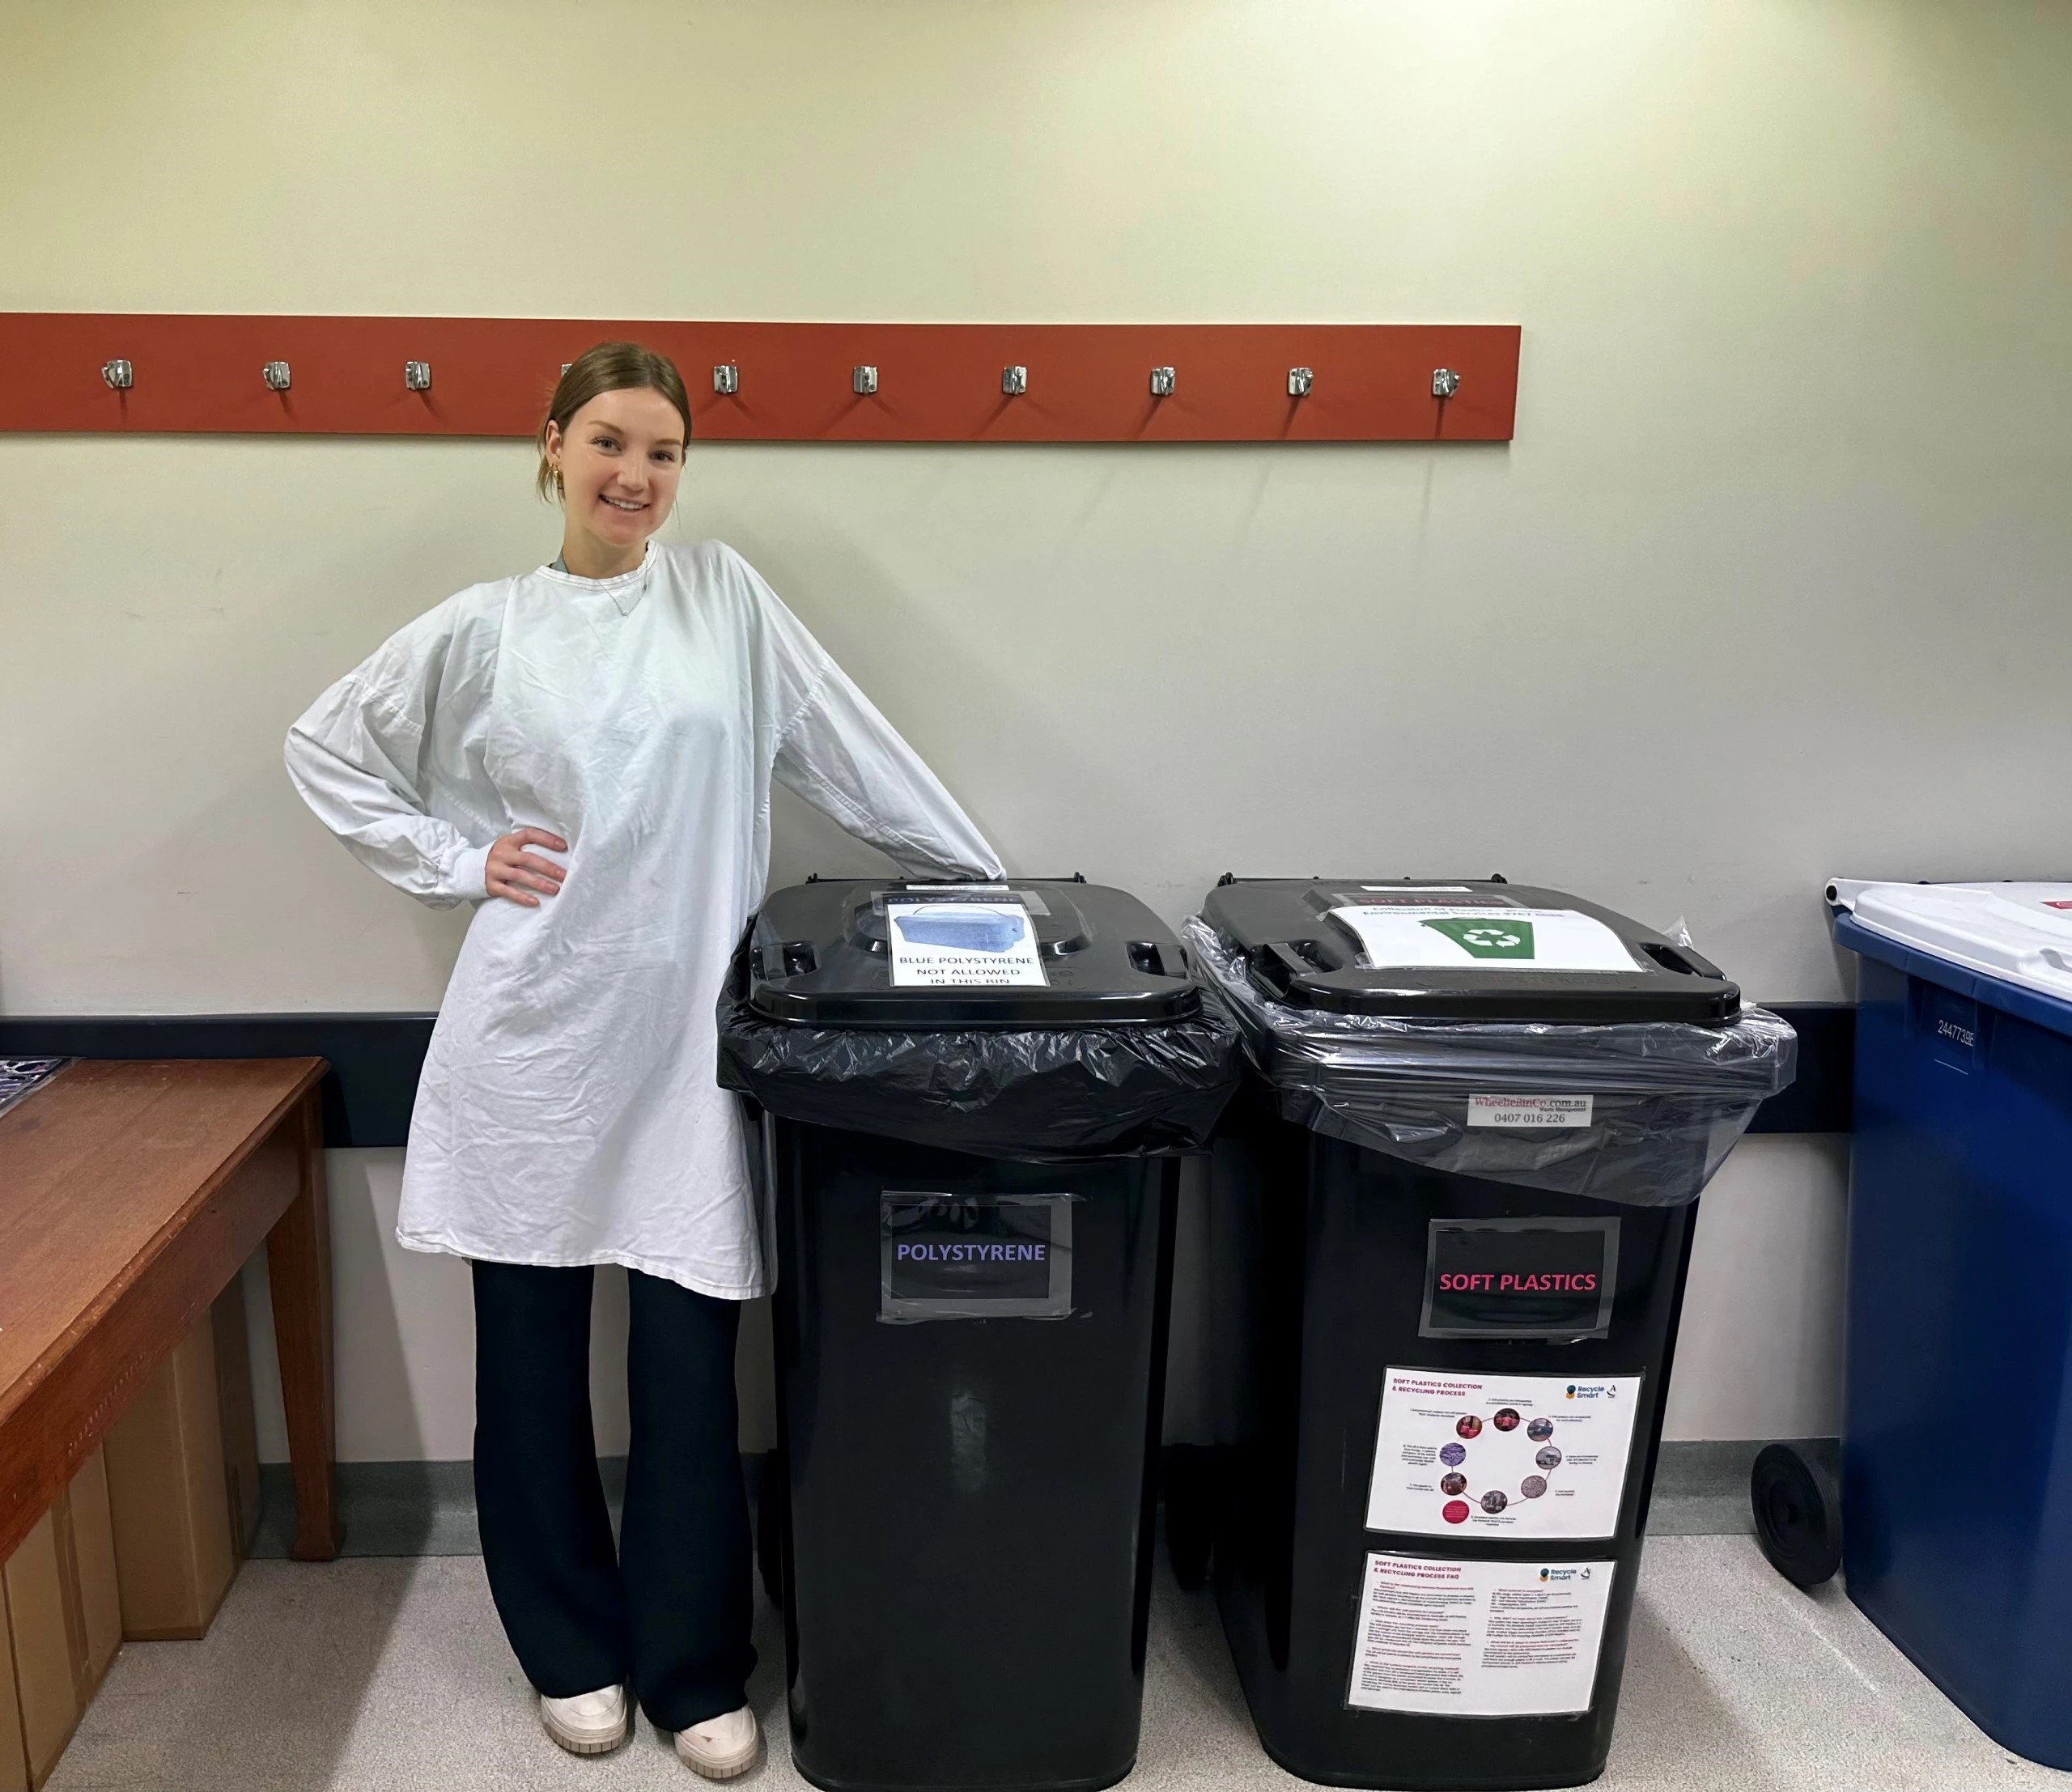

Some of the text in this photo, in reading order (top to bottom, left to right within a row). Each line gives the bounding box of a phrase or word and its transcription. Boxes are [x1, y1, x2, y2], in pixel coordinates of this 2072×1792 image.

[1494, 1113, 1565, 1123] 0407 016 226
[898, 1243, 1046, 1261] POLYSTYRENE
[1439, 1273, 1596, 1291] SOFT PLASTICS
[1412, 1379, 1442, 1387] PLASTICS
[1443, 1382, 1483, 1390] COLLECTION
[1399, 1386, 1435, 1395] RECYCLING
[1392, 1562, 1422, 1570] PLASTICS
[1380, 1568, 1415, 1578] RECYCLING
[1416, 1571, 1446, 1579] PROCESS
